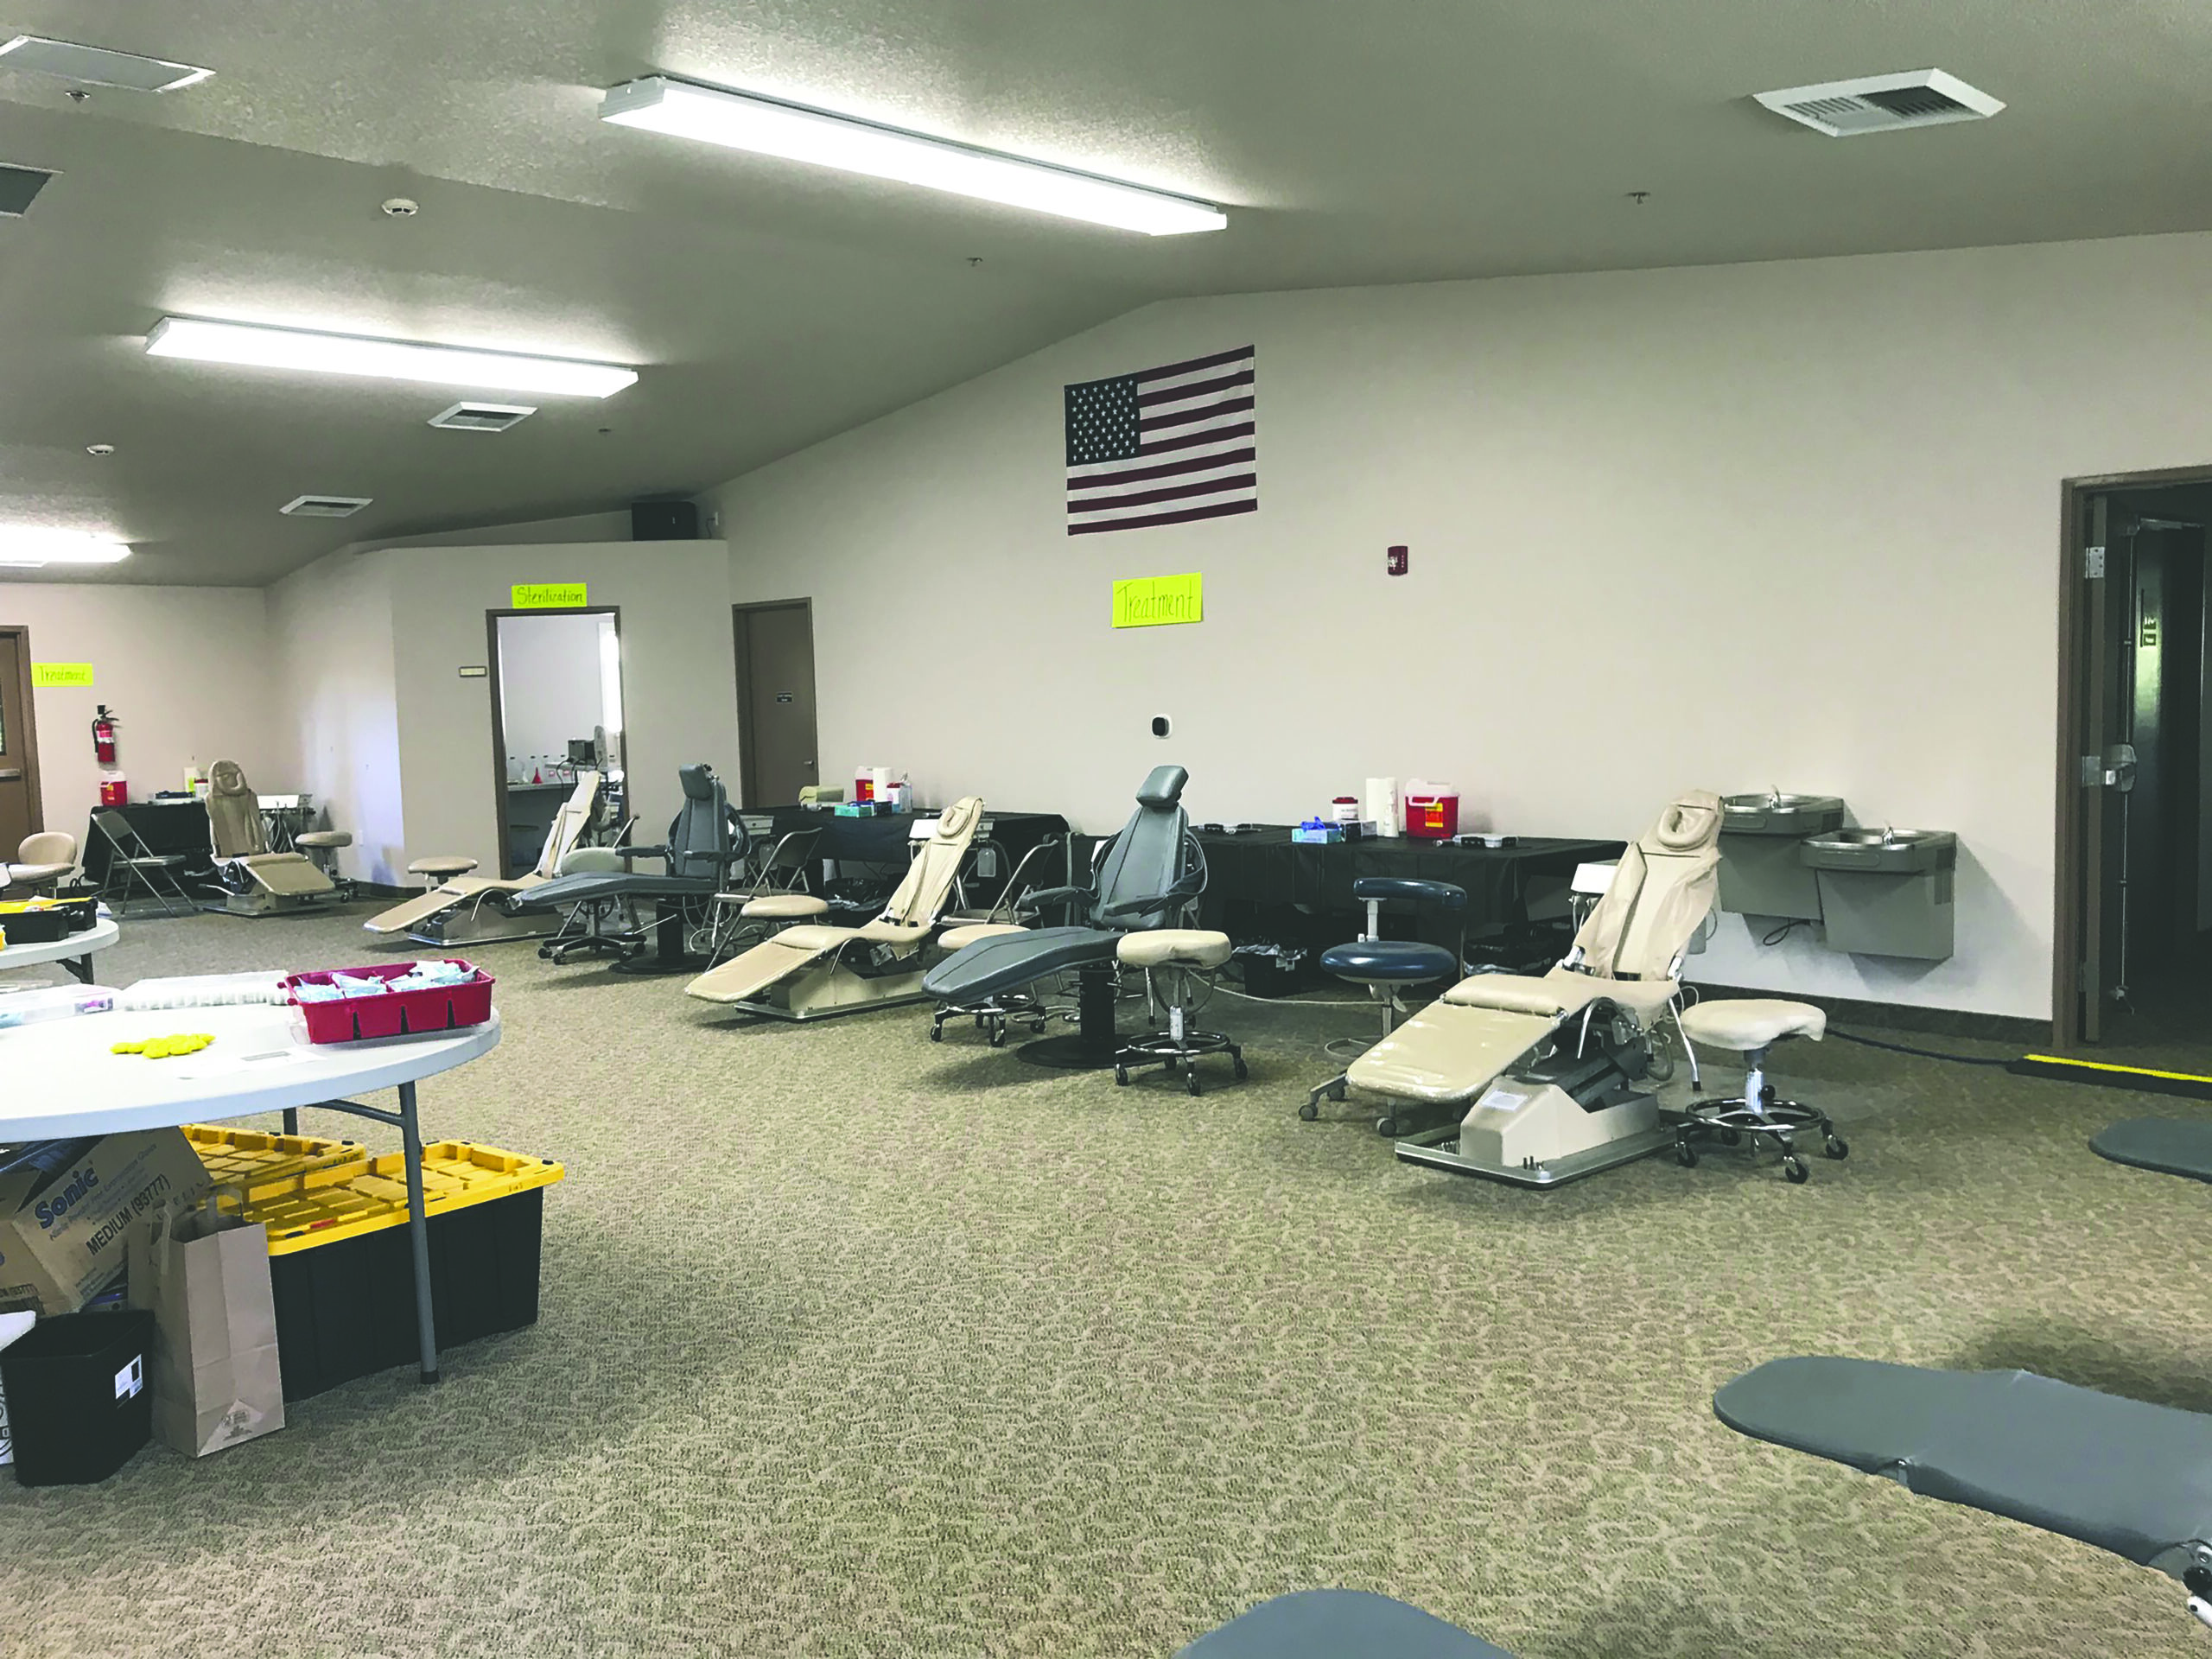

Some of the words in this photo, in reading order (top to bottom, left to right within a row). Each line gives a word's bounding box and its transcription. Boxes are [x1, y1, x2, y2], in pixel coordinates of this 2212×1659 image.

[517, 586, 583, 605] Sterilization
[1116, 579, 1193, 623] Treatment
[38, 665, 86, 682] Treatment
[35, 1166, 99, 1230] Sonic
[86, 1206, 134, 1256] MEDIUM
[130, 1173, 171, 1217] (93777)
